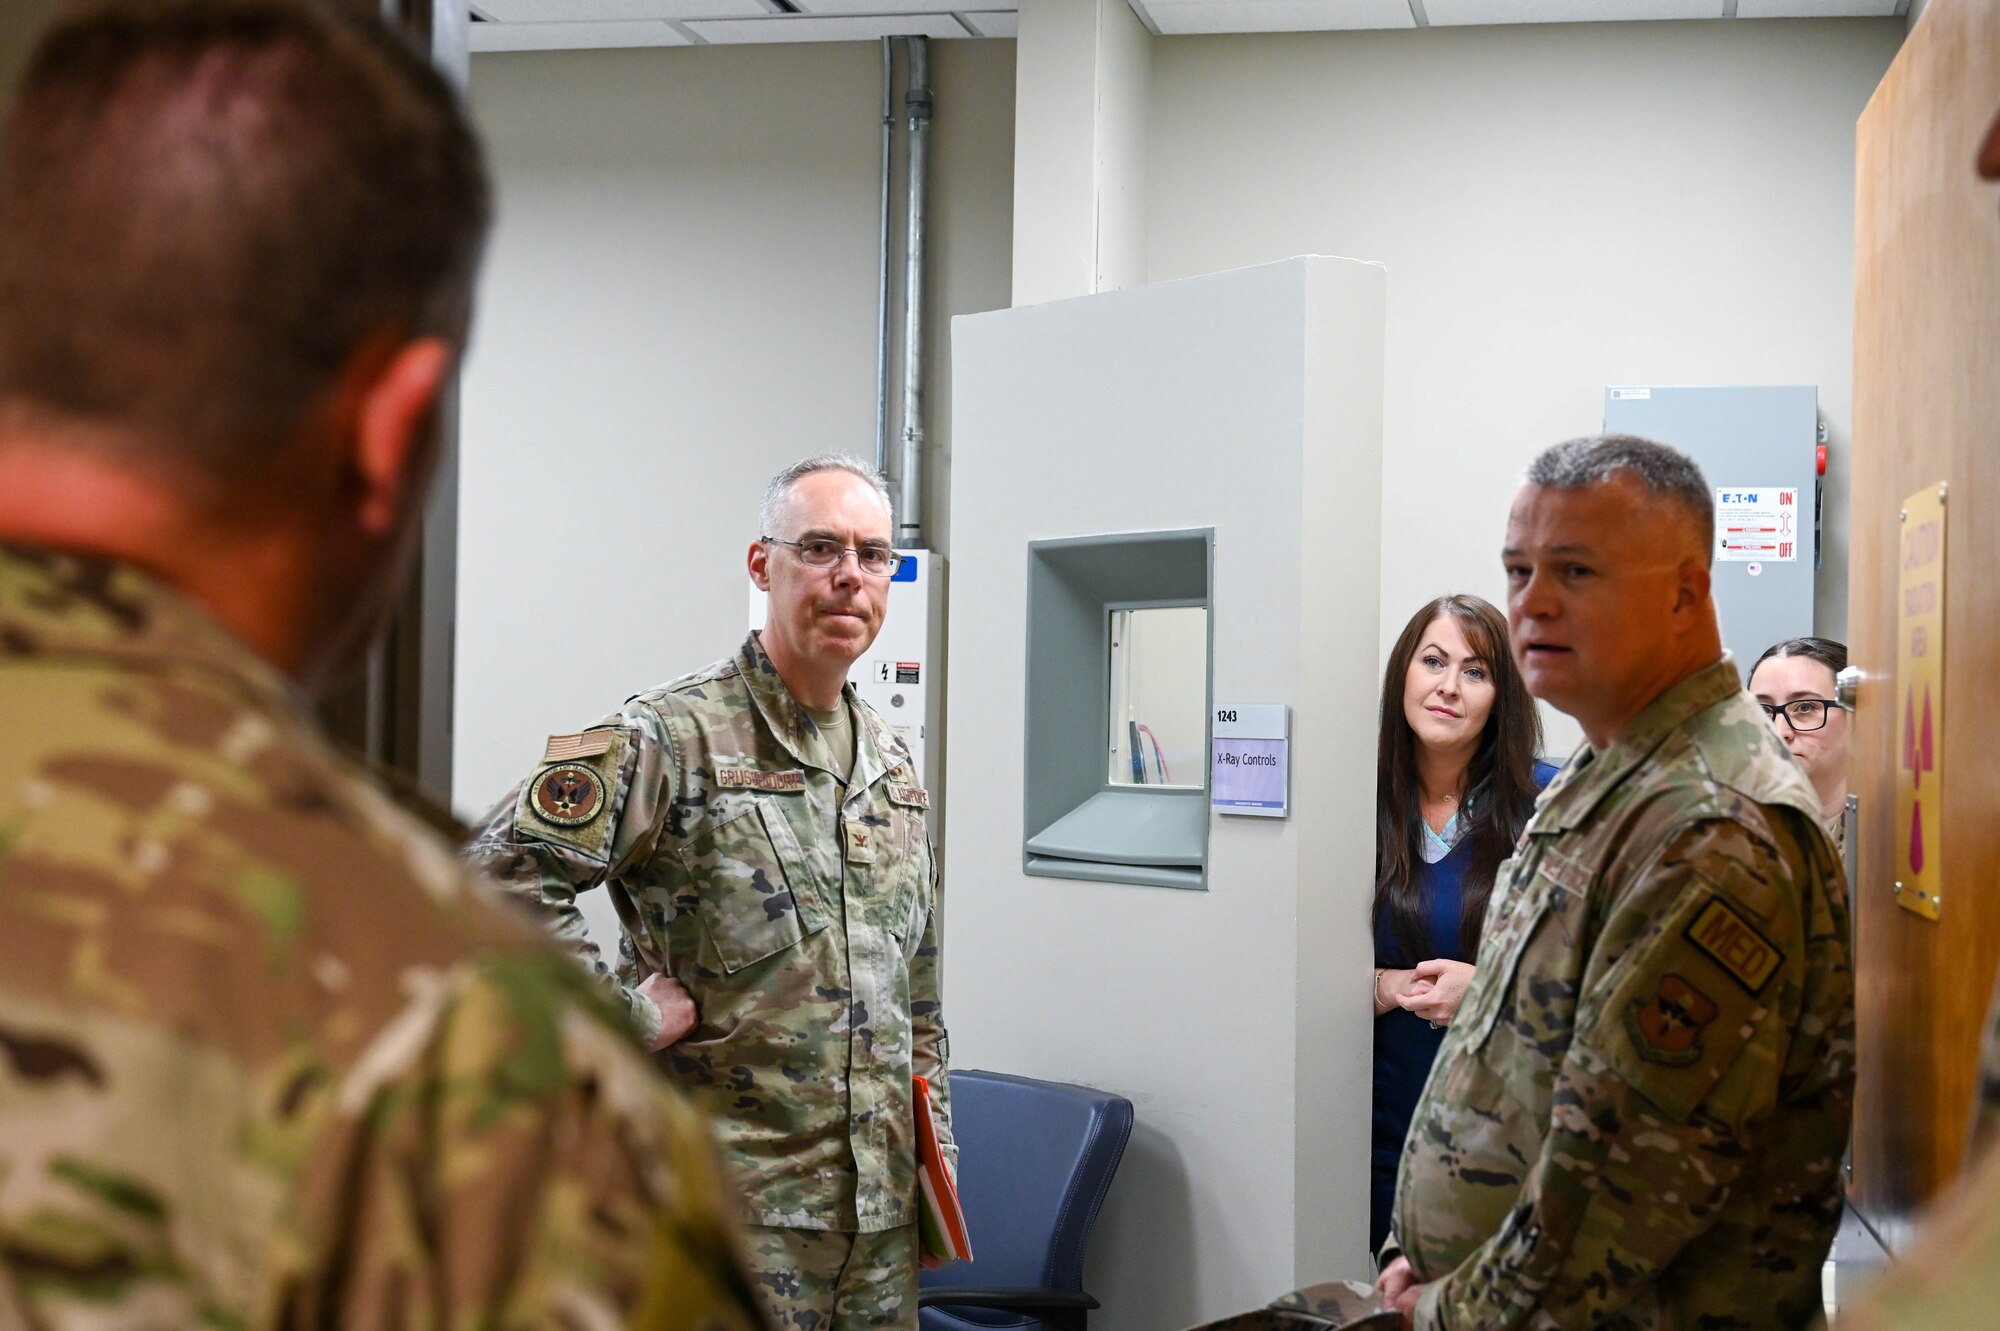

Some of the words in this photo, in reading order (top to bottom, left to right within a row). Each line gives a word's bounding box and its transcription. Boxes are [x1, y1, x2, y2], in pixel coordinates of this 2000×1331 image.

[1779, 492, 1792, 506] ON
[1779, 542, 1793, 557] OFF
[1217, 710, 1237, 722] 1243
[1217, 753, 1240, 767] X-Ray
[1242, 753, 1276, 766] Controls
[1699, 909, 1769, 979] MED
